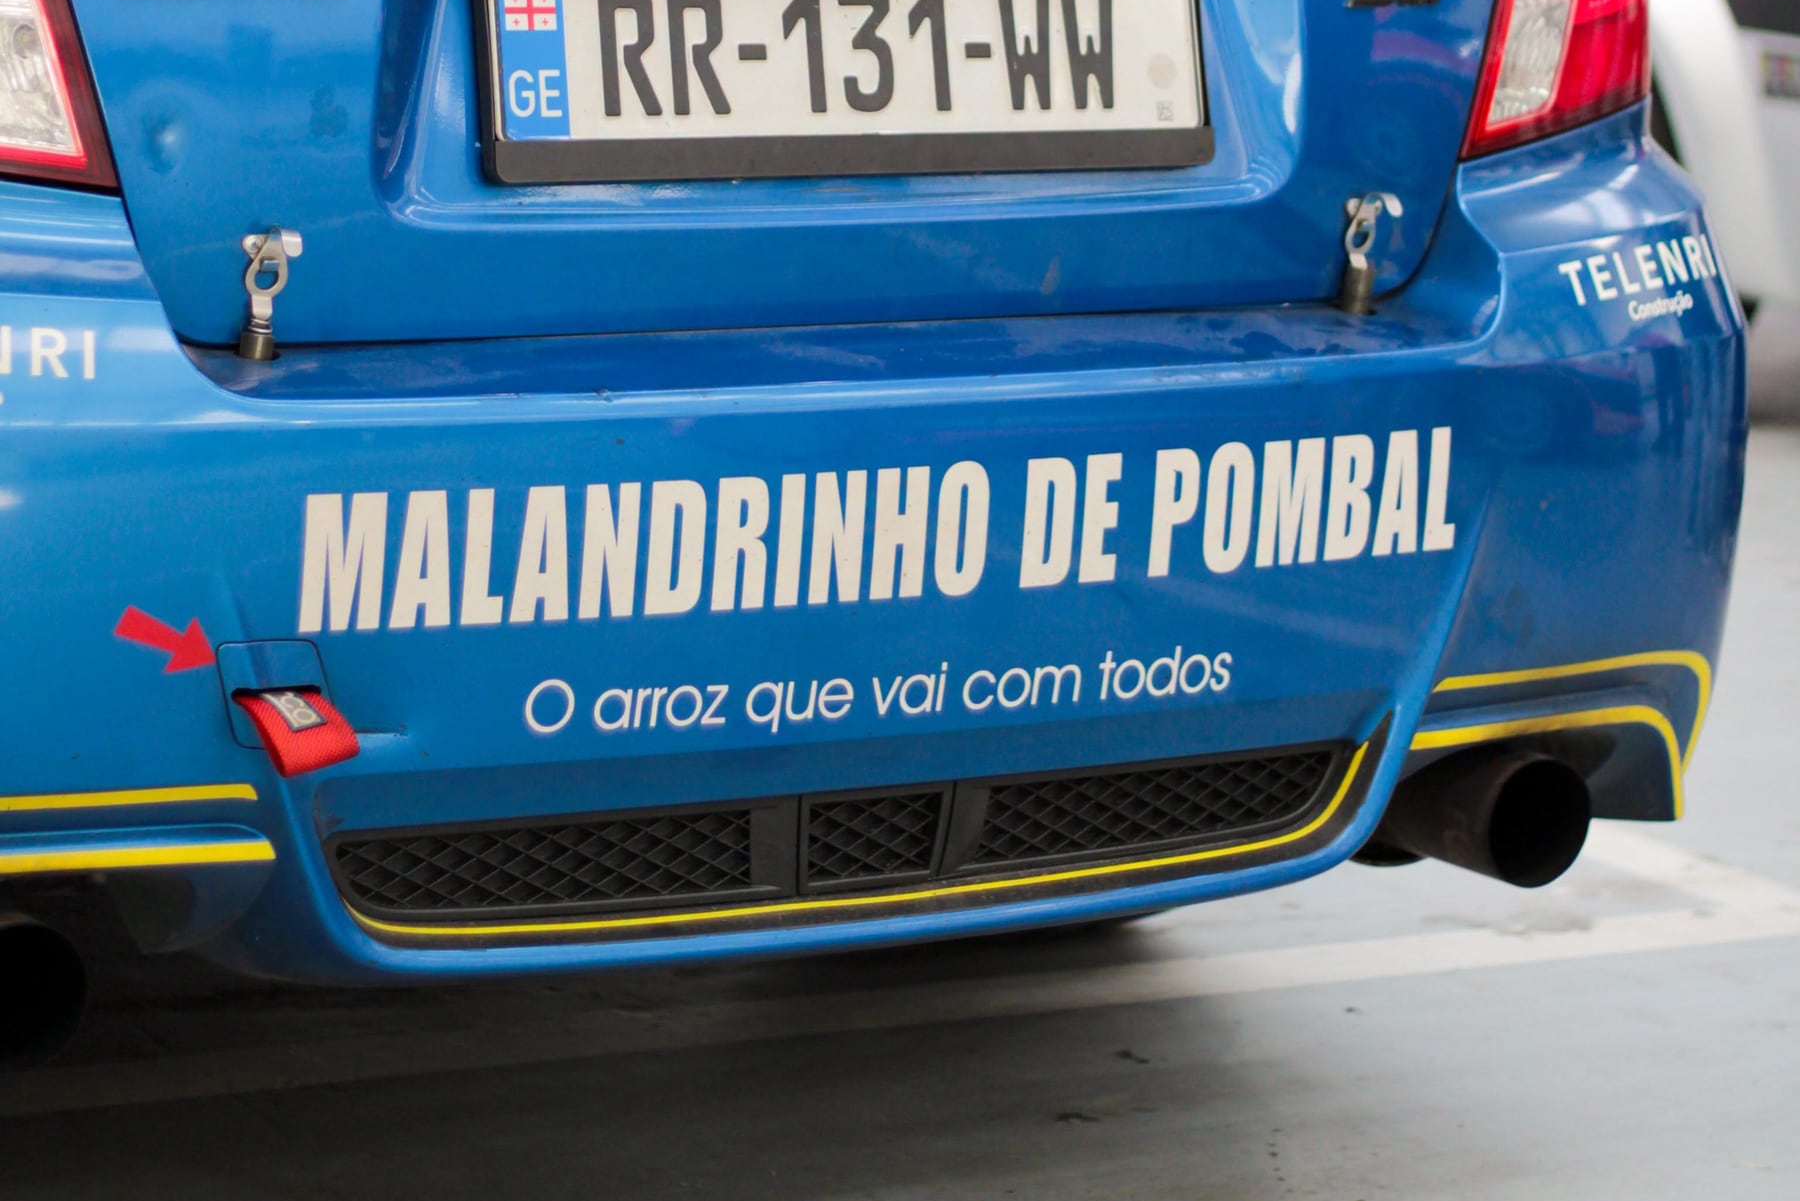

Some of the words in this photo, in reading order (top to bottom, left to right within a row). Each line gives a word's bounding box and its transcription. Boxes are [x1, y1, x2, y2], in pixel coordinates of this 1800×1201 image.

[508, 69, 563, 119] GE
[1557, 233, 1718, 307] TELENRI
[298, 460, 990, 633] MALANDRINHO
[1019, 452, 1123, 588] DE
[1147, 426, 1455, 578] POMBAL
[524, 678, 576, 734] O
[592, 683, 729, 731] arroz
[745, 675, 855, 734] que
[871, 662, 947, 716] vai
[962, 663, 1082, 711] com
[1098, 644, 1233, 701] todos
